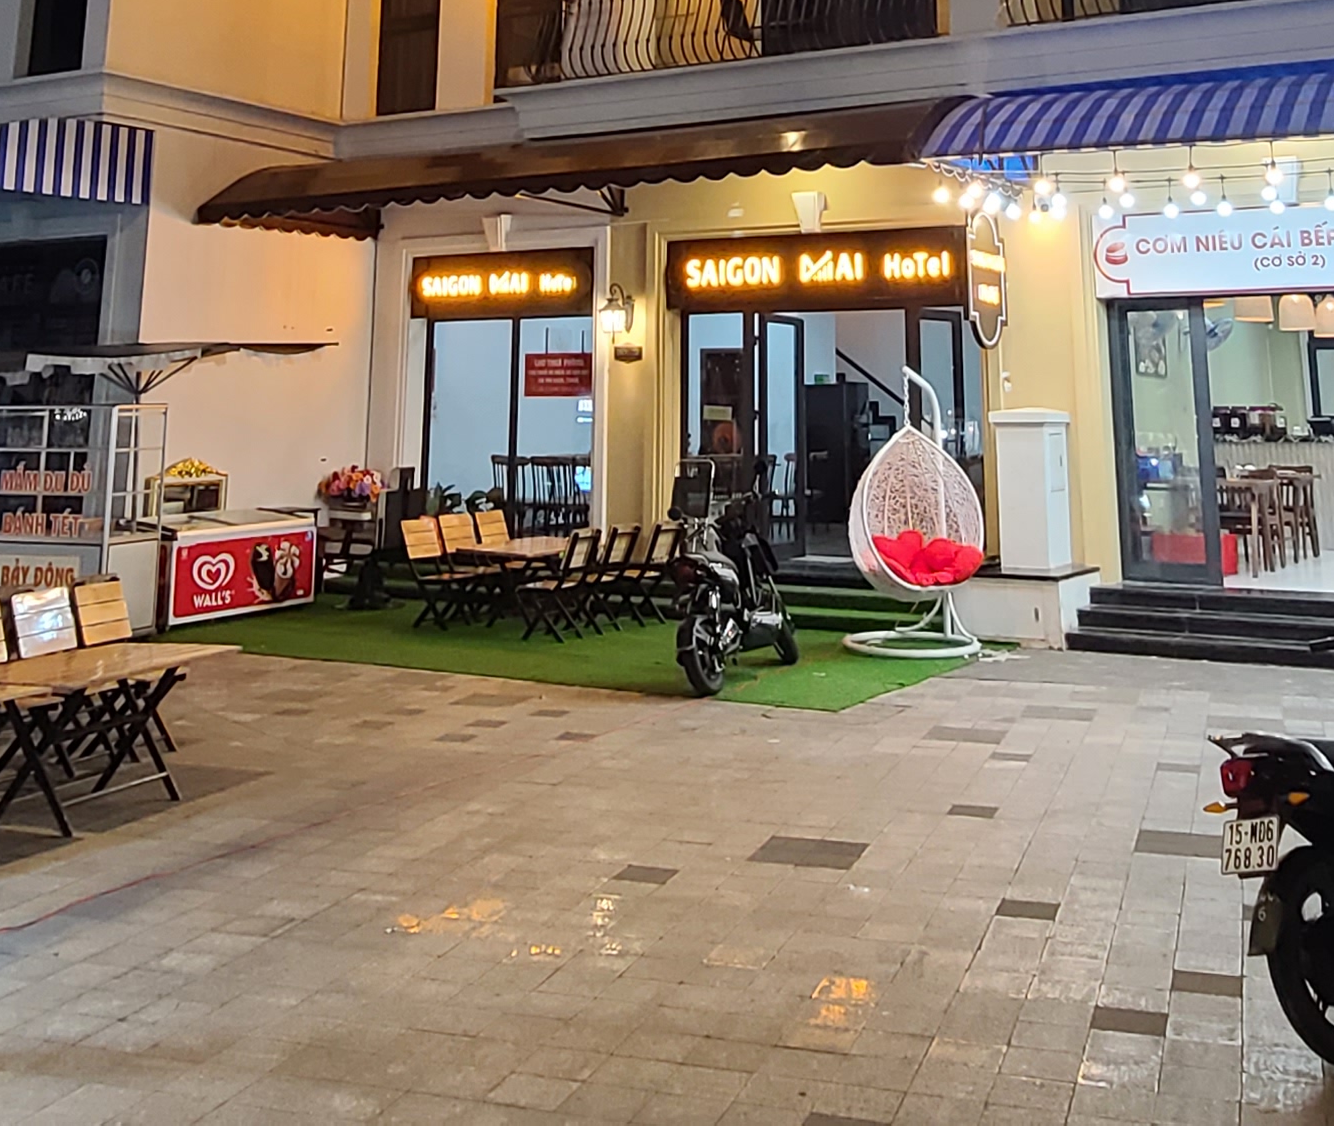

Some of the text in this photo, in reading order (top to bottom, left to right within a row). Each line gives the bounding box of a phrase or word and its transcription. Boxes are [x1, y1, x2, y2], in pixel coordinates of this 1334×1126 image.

[1135, 234, 1188, 255] CƠM
[1250, 225, 1292, 249] CÁI
[685, 256, 781, 289] SAIGON
[1253, 251, 1326, 271] (CƠ SỞ 2)
[421, 274, 482, 298] SAIGON
[1, 506, 47, 535] BÁNH
[193, 590, 231, 609] WALL'S
[1225, 844, 1275, 871] 768.30
